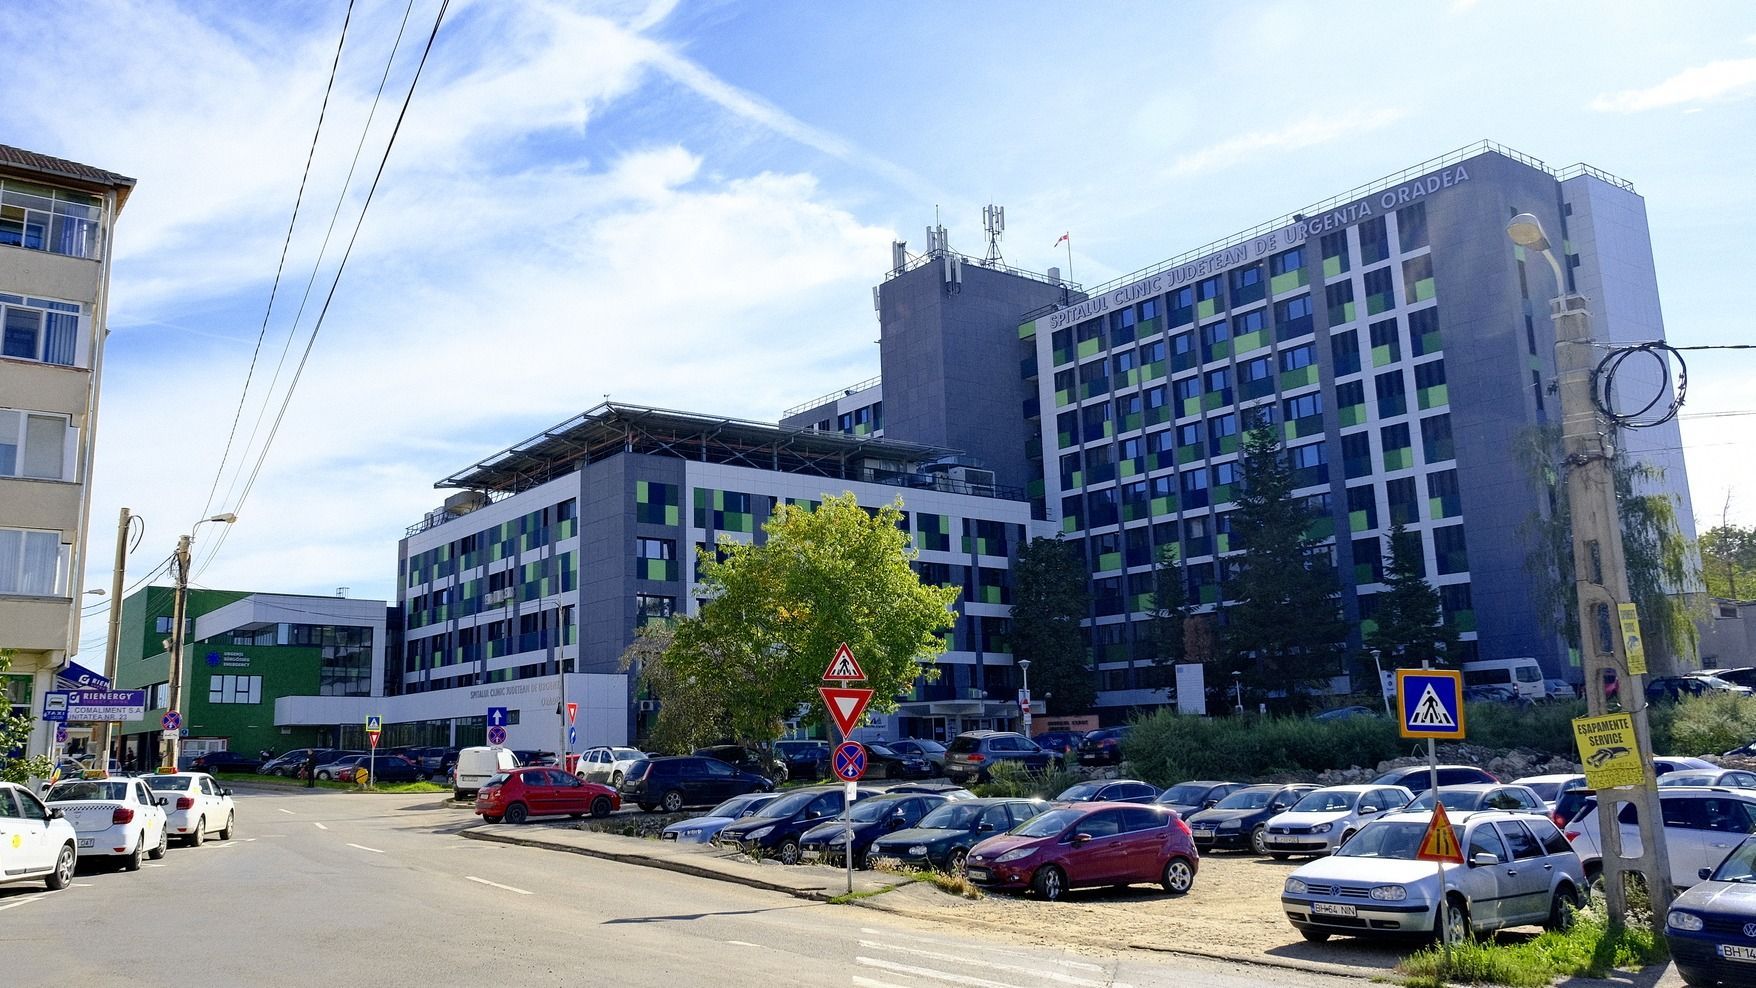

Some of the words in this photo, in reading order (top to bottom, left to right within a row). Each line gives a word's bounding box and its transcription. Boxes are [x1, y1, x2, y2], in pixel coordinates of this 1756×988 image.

[1050, 298, 1108, 328] SPITALUL
[1113, 277, 1162, 305] CLINIC
[1167, 245, 1248, 287] JUDETEAN
[1255, 234, 1277, 256] DE
[1284, 201, 1372, 244] URGENTA
[1381, 165, 1470, 209] ORADEA
[1588, 732, 1624, 747] SERVICE
[1724, 946, 1741, 957] BH
